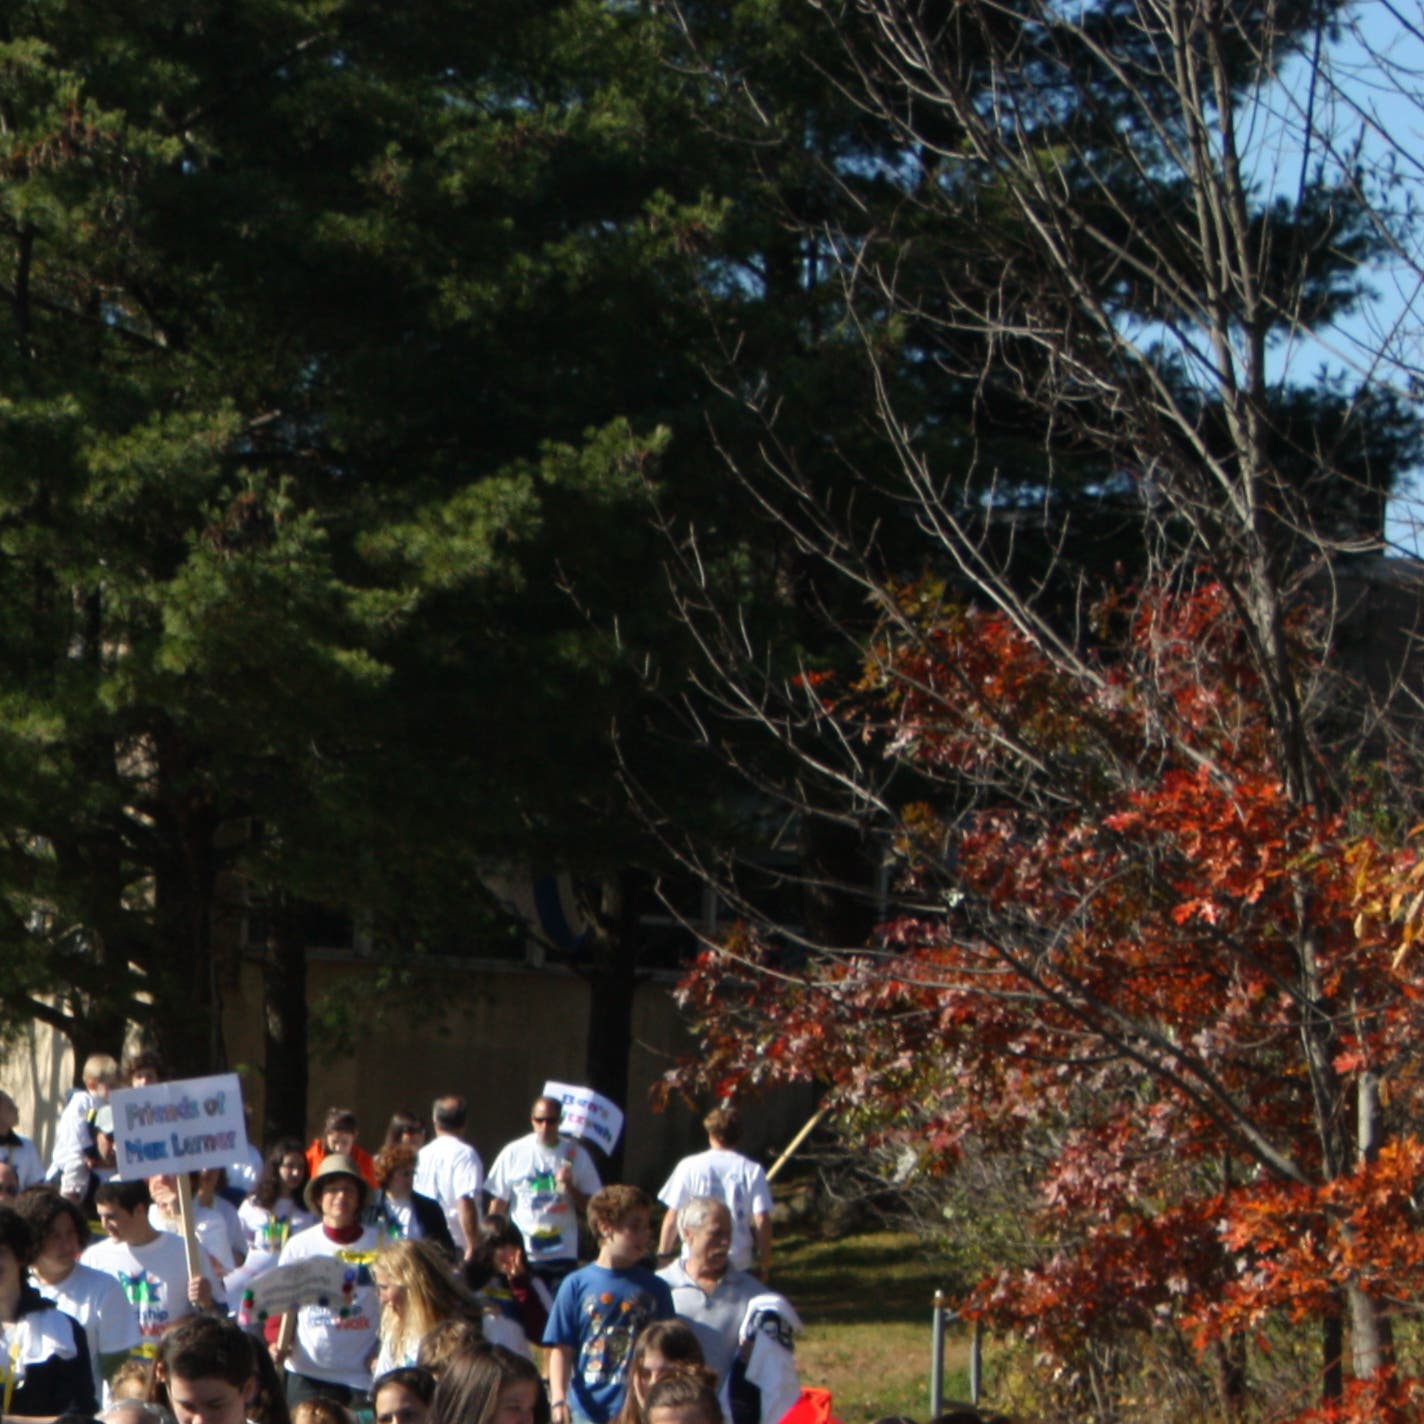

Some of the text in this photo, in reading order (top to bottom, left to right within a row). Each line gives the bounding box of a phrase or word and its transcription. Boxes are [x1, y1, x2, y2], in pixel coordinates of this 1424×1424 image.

[125, 1090, 226, 1131] Friends of
[124, 1138, 169, 1164] Max
